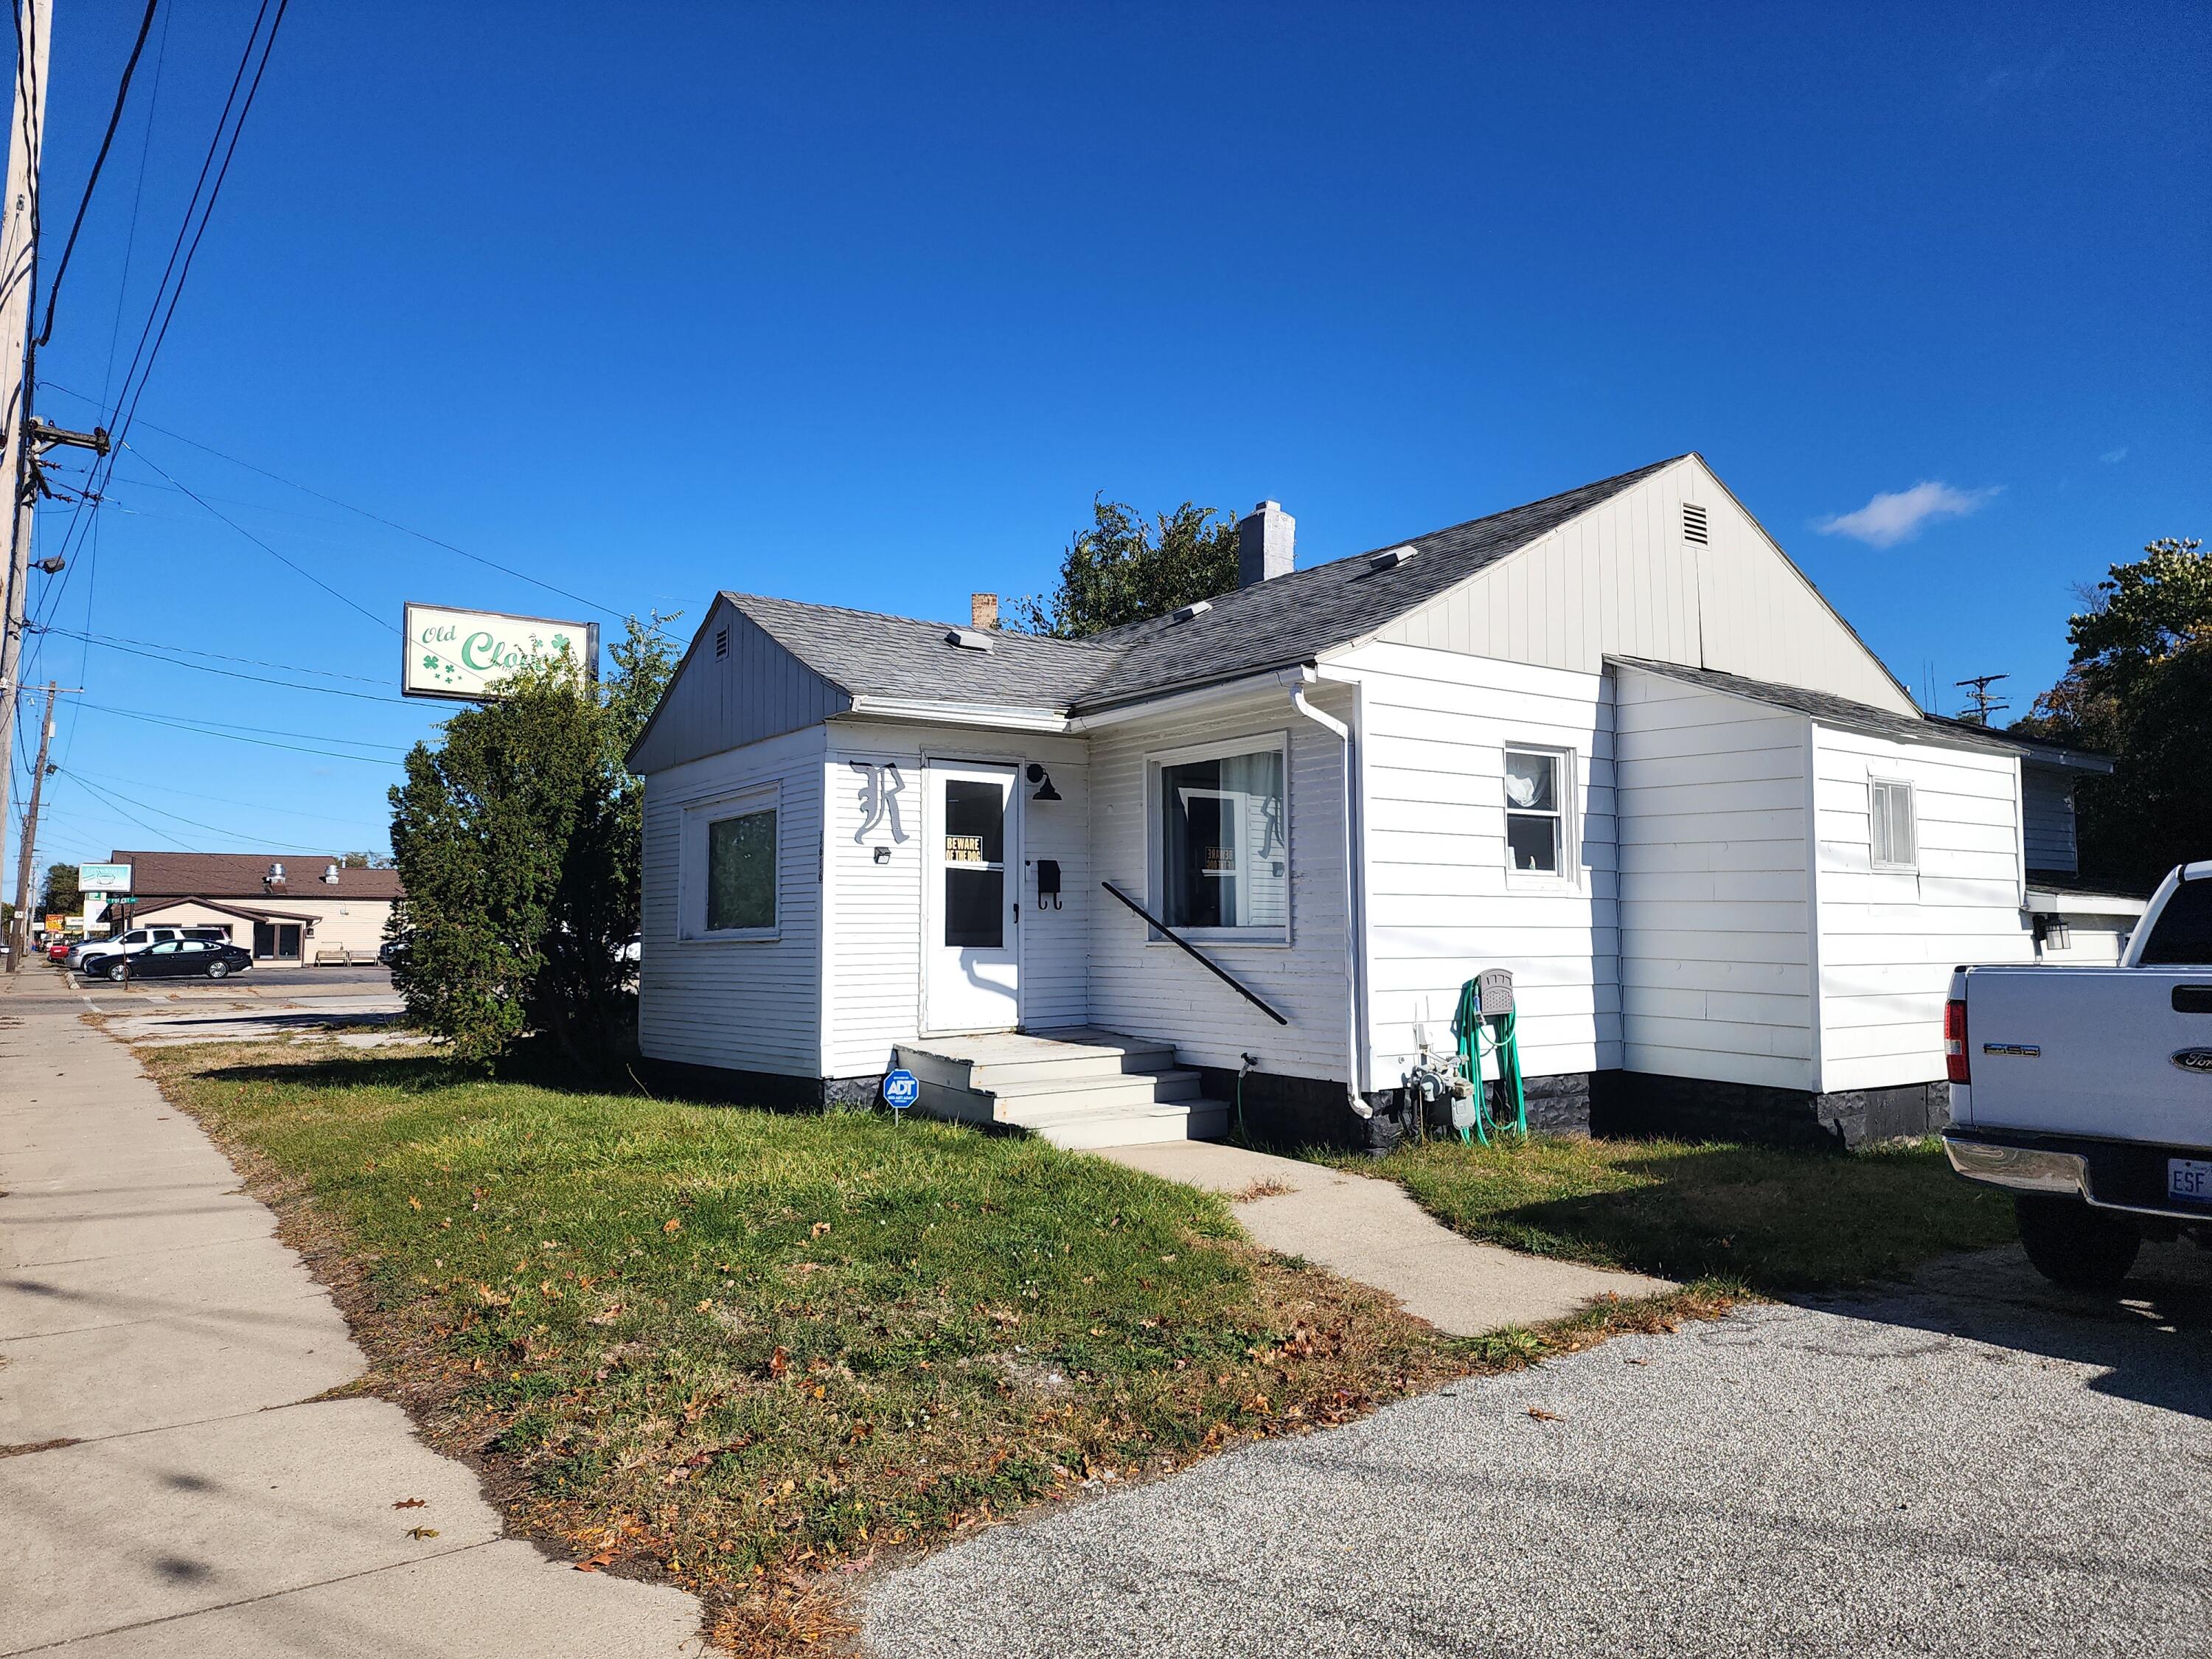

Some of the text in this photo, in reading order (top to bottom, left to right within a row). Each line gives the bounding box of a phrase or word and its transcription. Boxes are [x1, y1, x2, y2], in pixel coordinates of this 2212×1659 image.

[422, 625, 457, 644] Old
[462, 632, 554, 672] Clo
[849, 759, 910, 845] R
[947, 838, 980, 850] BEWARE
[946, 849, 981, 861] OF THE DOG
[2185, 1052, 2212, 1067] For
[887, 1080, 915, 1096] ADT
[2174, 1171, 2205, 1192] ESF
